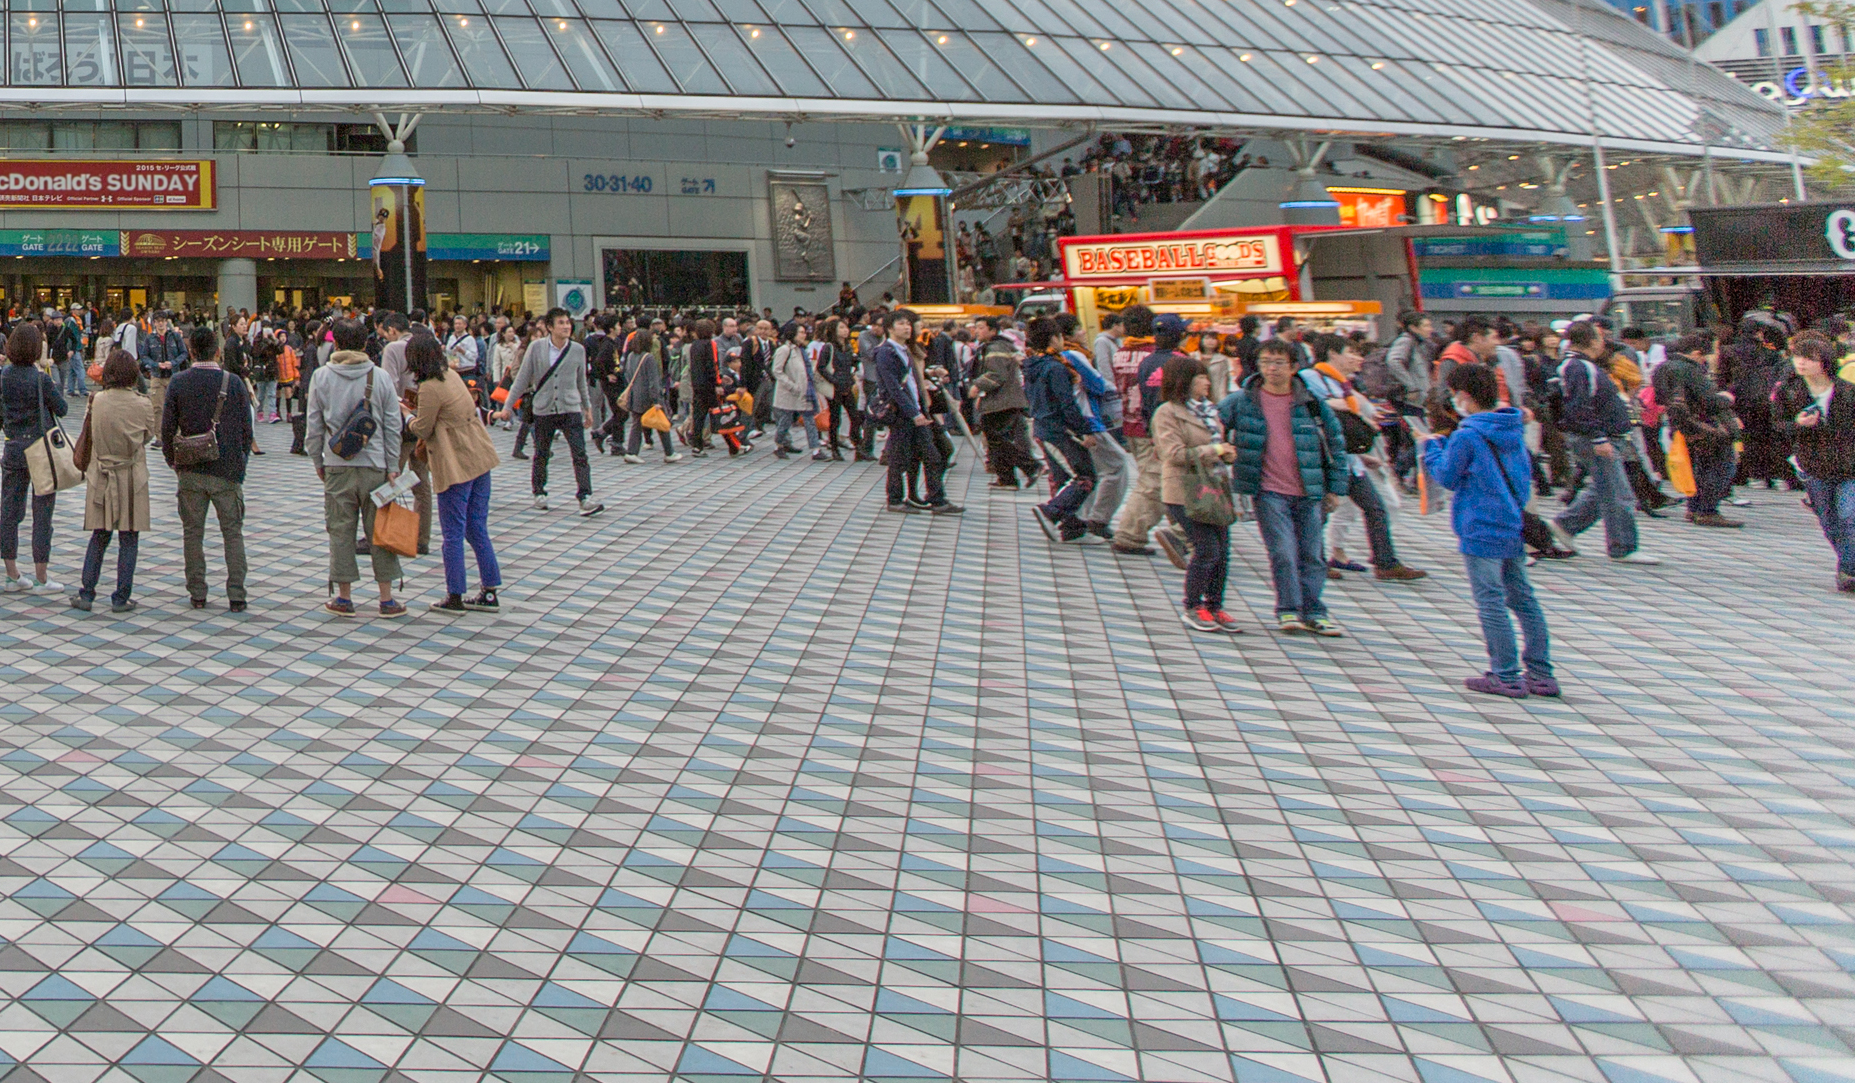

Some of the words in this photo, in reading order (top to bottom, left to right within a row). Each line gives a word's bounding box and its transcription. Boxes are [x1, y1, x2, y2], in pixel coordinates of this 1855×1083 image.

[135, 164, 155, 172] 2015
[106, 173, 199, 192] SUNDAY
[680, 186, 700, 194] GATE
[22, 234, 44, 243] ゲート
[81, 234, 103, 243] ゲート
[21, 243, 44, 251] GATE
[172, 234, 343, 253] シーズンシート専用ゲート
[514, 241, 530, 255] 21
[1078, 244, 1205, 273] BASEBALL
